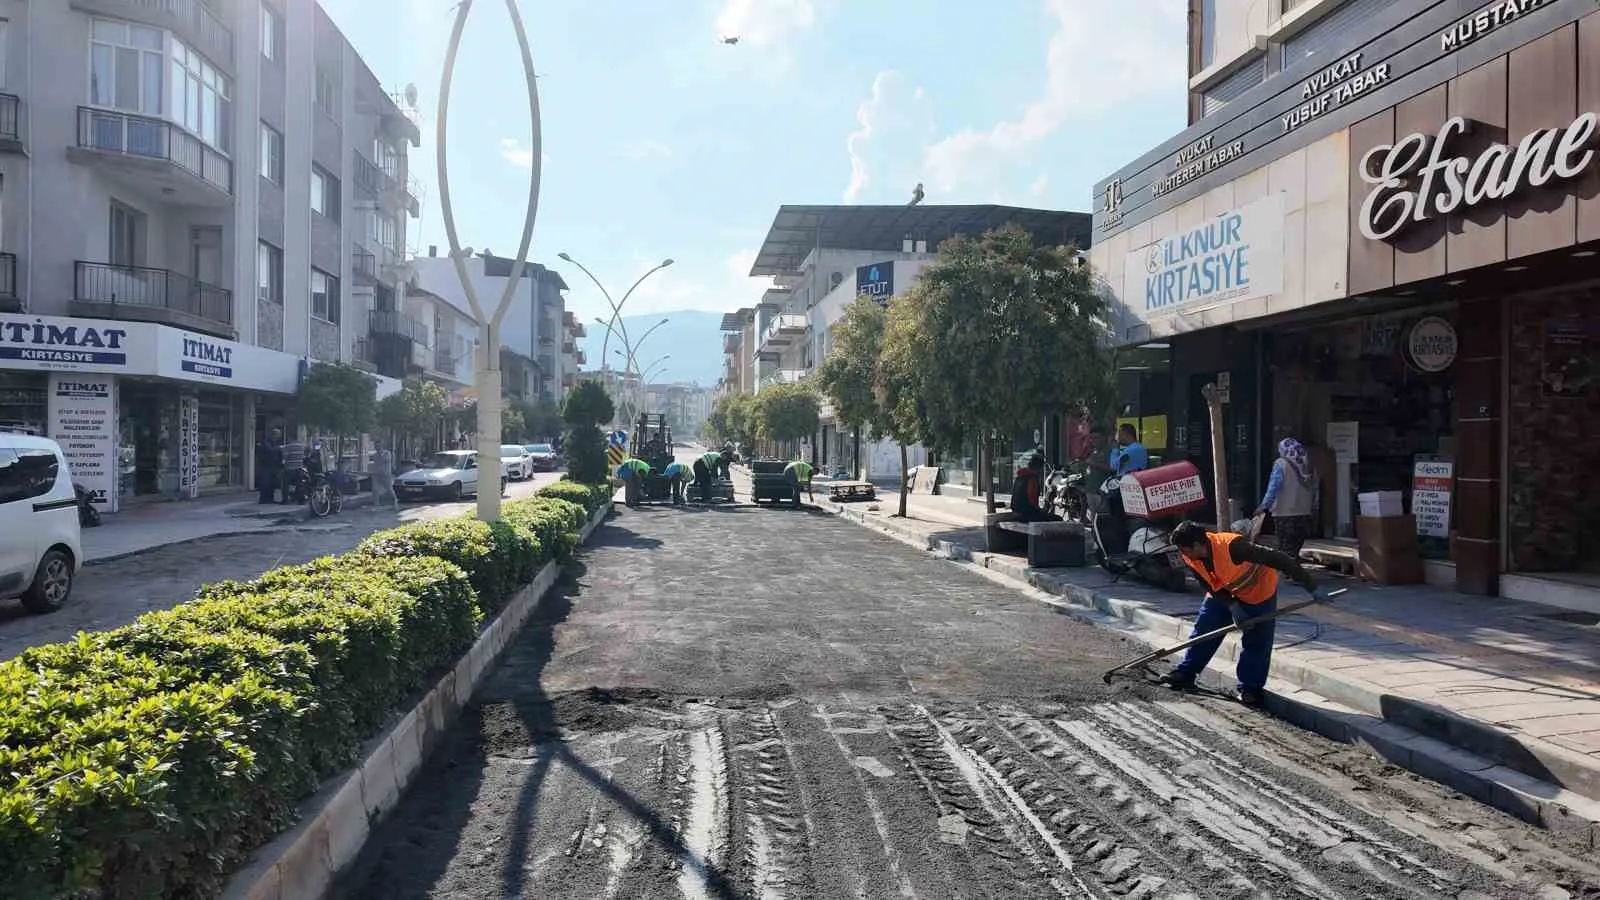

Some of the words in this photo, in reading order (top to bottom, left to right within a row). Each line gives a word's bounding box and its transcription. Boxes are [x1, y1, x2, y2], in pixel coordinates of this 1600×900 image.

[1441, 0, 1540, 50] MUSTA
[1281, 92, 1331, 131] YUSUF
[1334, 63, 1390, 103] TABAR
[1302, 53, 1362, 99] AVUKAT
[1152, 159, 1206, 197] MUHTEREM
[1206, 141, 1244, 169] TABAR
[1175, 135, 1214, 167] AVUKAT
[1358, 112, 1598, 241] Efsane
[22, 350, 93, 361] KIRTASİYE
[1150, 482, 1177, 497] EFSANE
